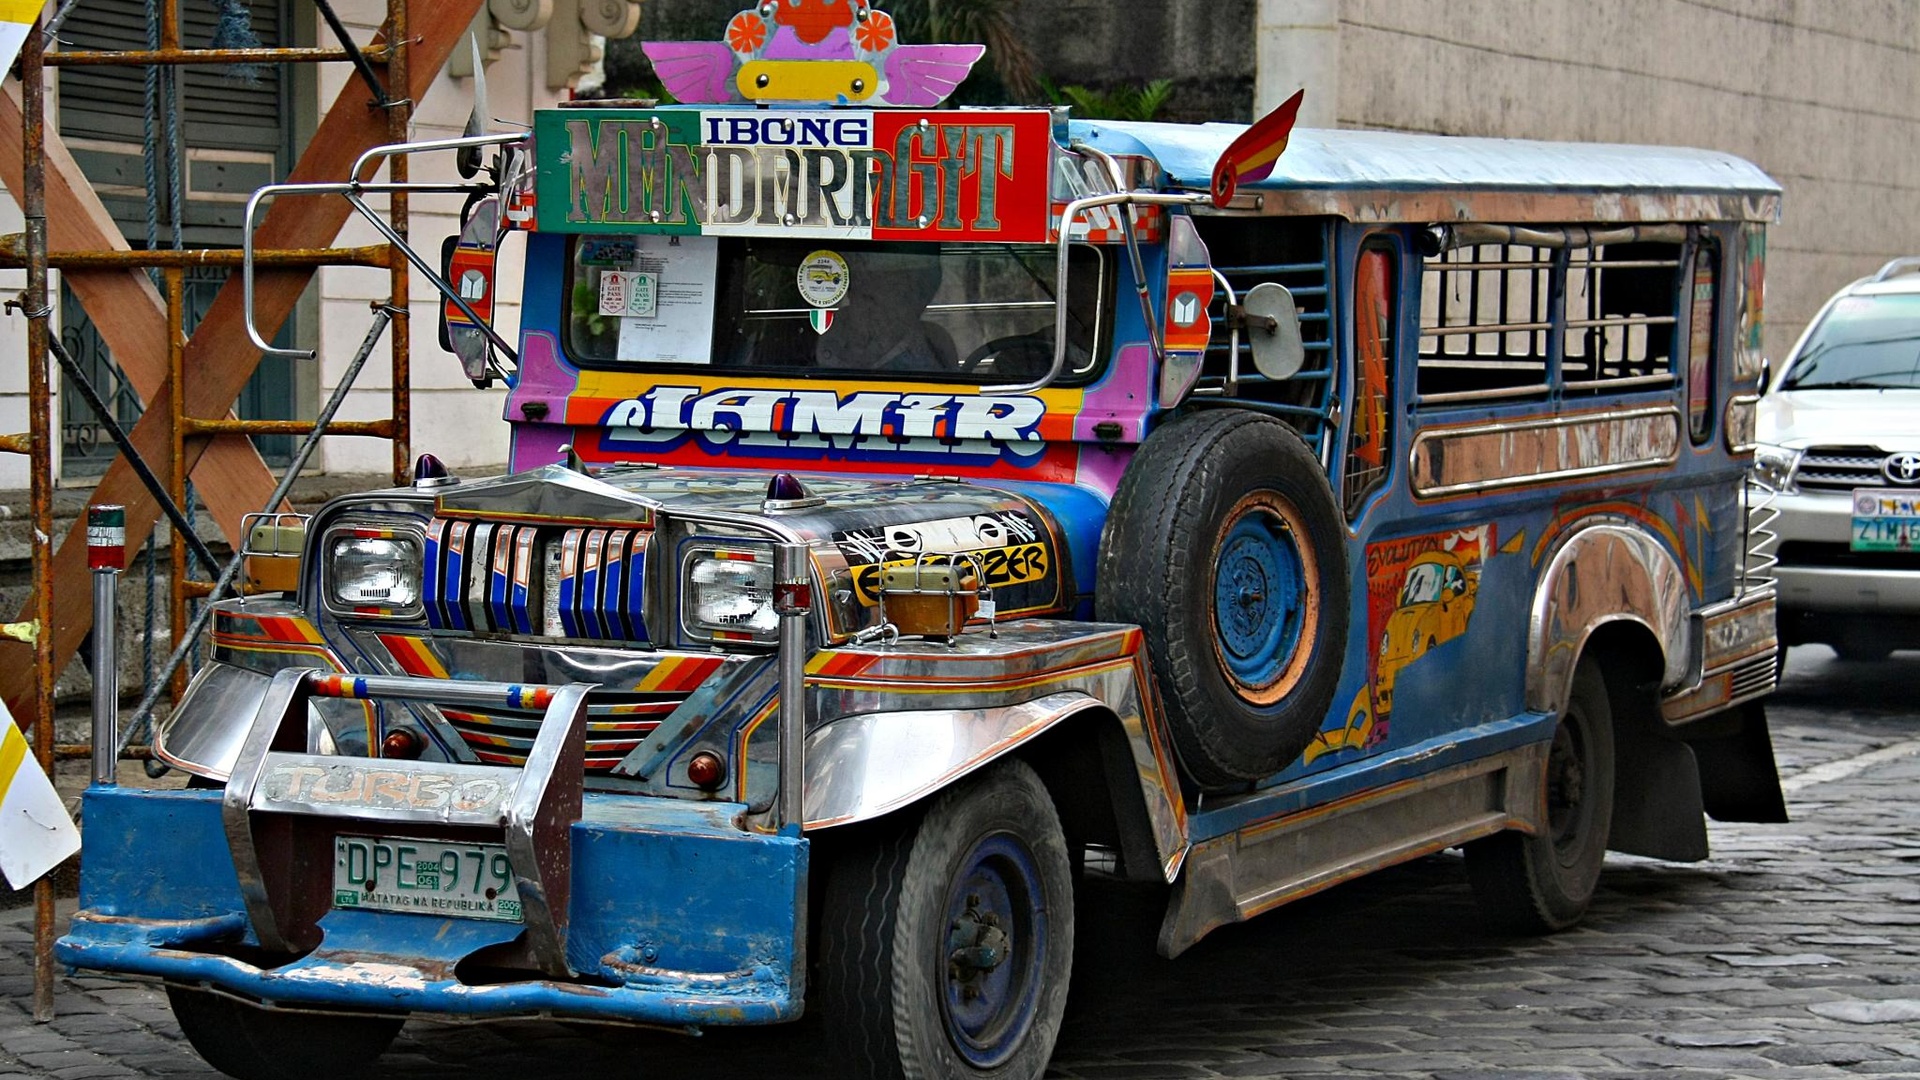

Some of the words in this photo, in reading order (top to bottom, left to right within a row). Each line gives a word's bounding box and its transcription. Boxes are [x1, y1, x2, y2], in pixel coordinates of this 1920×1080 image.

[705, 117, 868, 148] IBONG
[268, 764, 501, 811] TURBO
[347, 842, 418, 890] DPE
[440, 850, 512, 896] 979
[418, 862, 439, 871] 2004
[418, 876, 433, 885] 06
[361, 892, 409, 906] MATATAG
[413, 897, 428, 908] NA
[431, 897, 495, 912] REPUBLIKA
